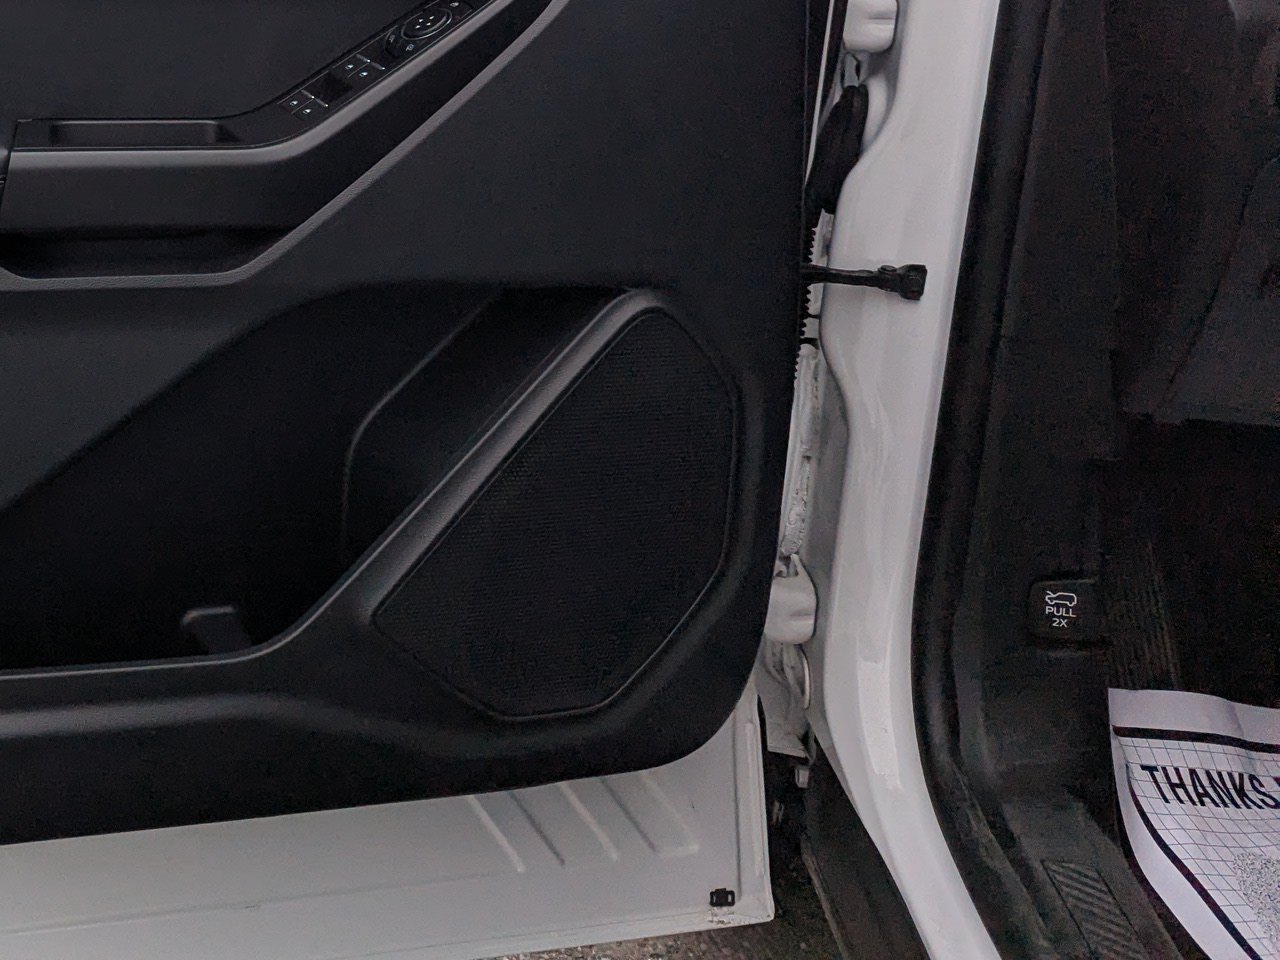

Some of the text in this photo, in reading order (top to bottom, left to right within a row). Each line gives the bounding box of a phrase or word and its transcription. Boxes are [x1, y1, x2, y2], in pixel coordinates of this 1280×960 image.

[1045, 605, 1077, 618] PULL
[1051, 617, 1068, 628] 2X
[1140, 765, 1280, 810] THANKS
